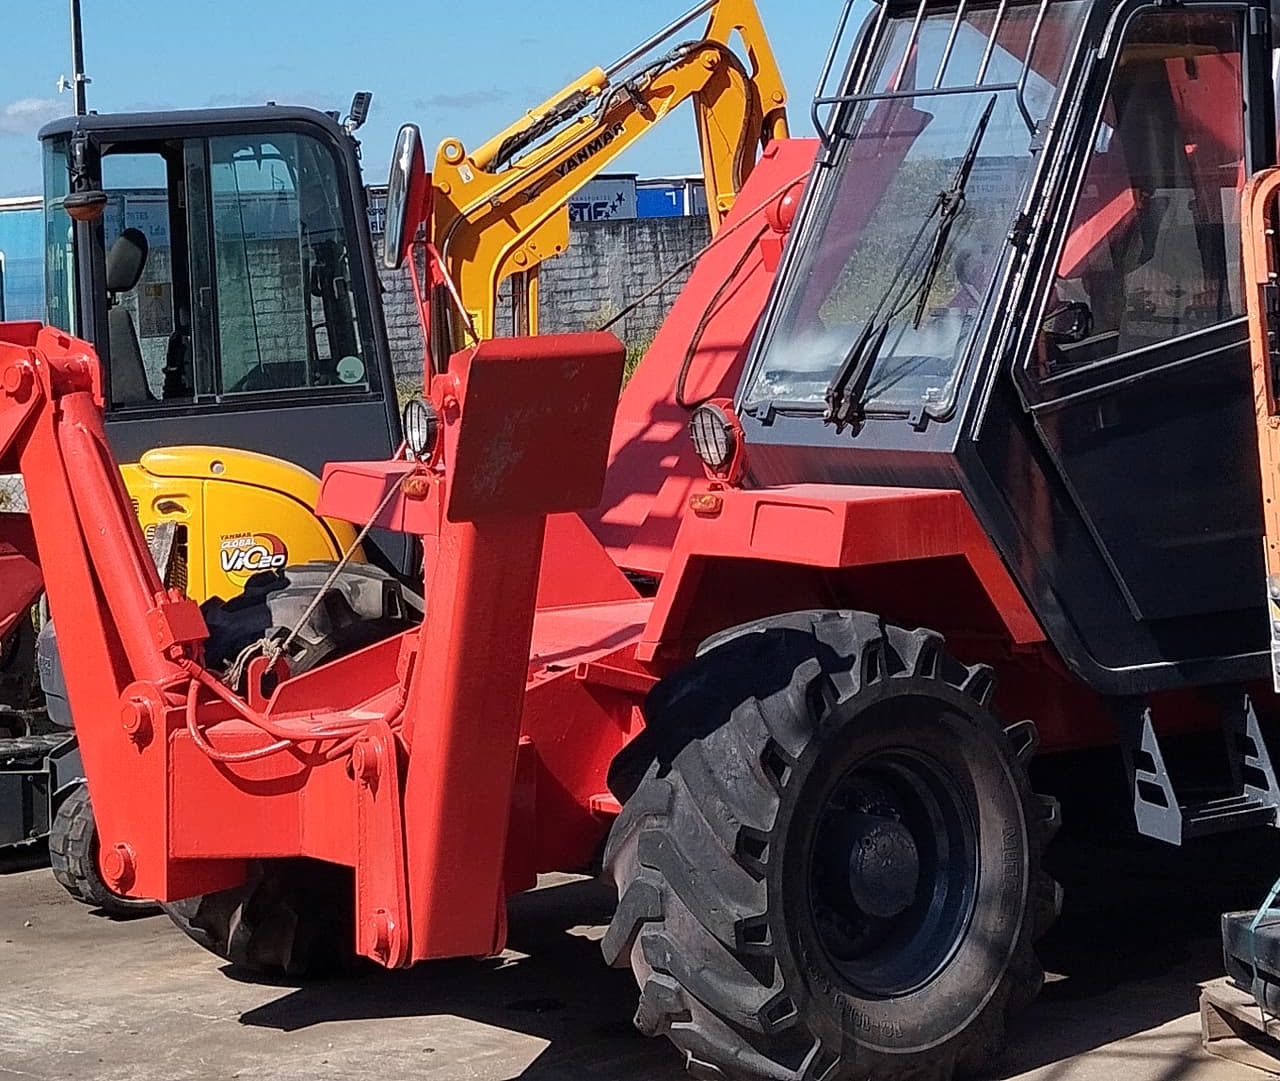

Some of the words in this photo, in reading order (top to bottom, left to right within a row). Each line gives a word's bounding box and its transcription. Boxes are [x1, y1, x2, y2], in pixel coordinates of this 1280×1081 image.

[556, 122, 625, 177] YANMAR
[570, 201, 609, 221] TIF
[221, 532, 252, 540] YANMAR
[222, 537, 256, 548] GLOBAL
